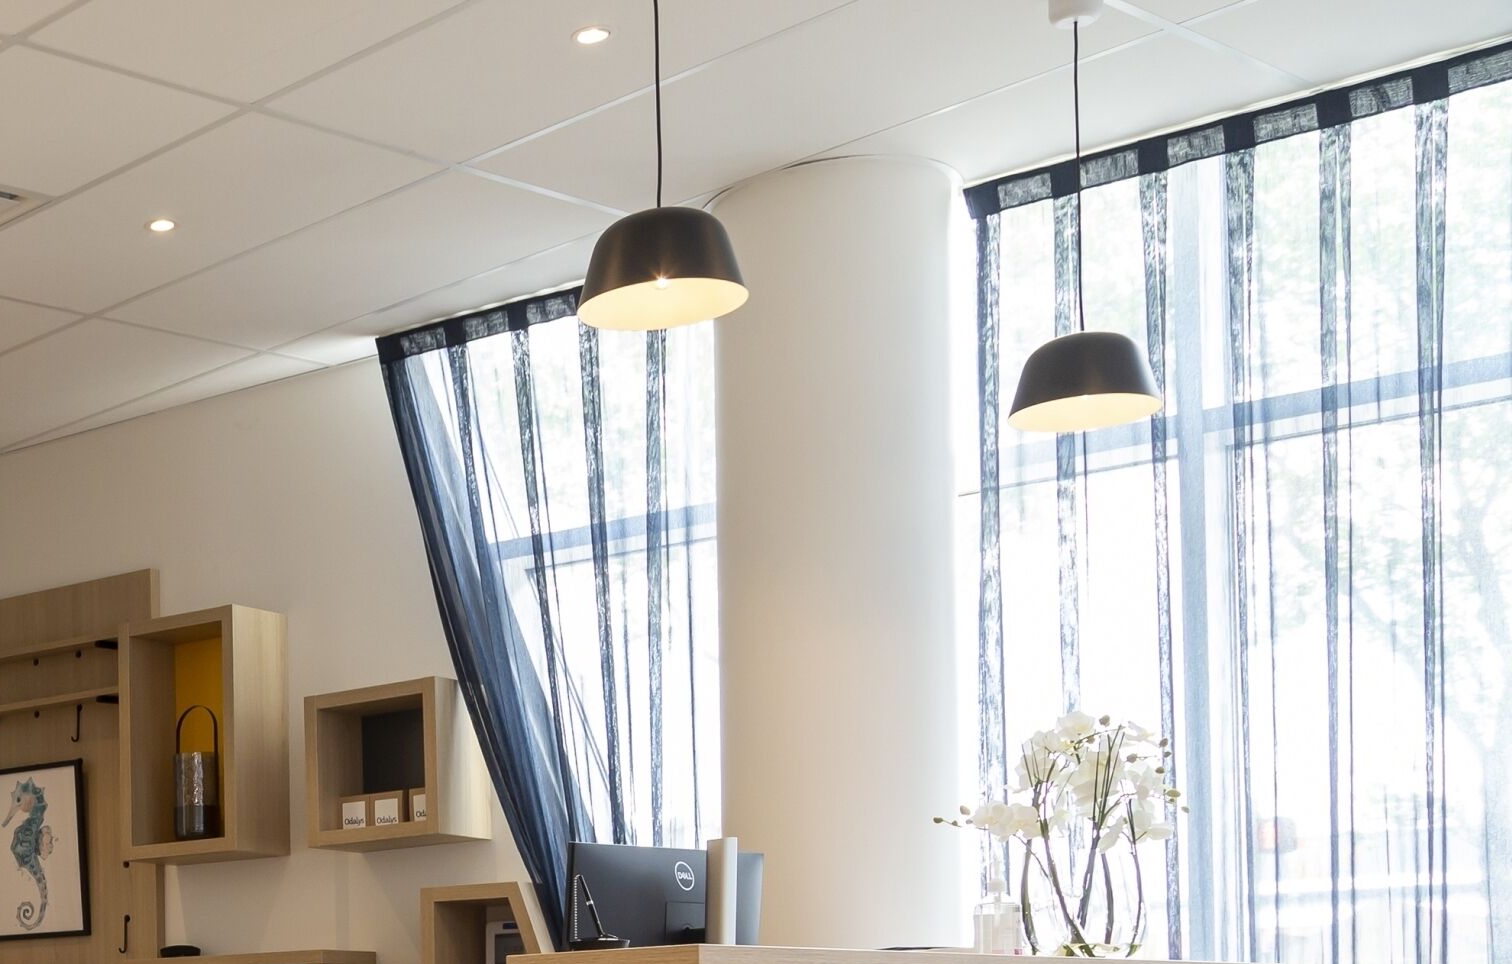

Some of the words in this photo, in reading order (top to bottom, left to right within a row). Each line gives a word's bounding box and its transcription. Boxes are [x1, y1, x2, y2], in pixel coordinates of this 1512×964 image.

[344, 816, 365, 826] Odalys
[376, 815, 398, 825] Odalys
[678, 872, 693, 880] DELL
